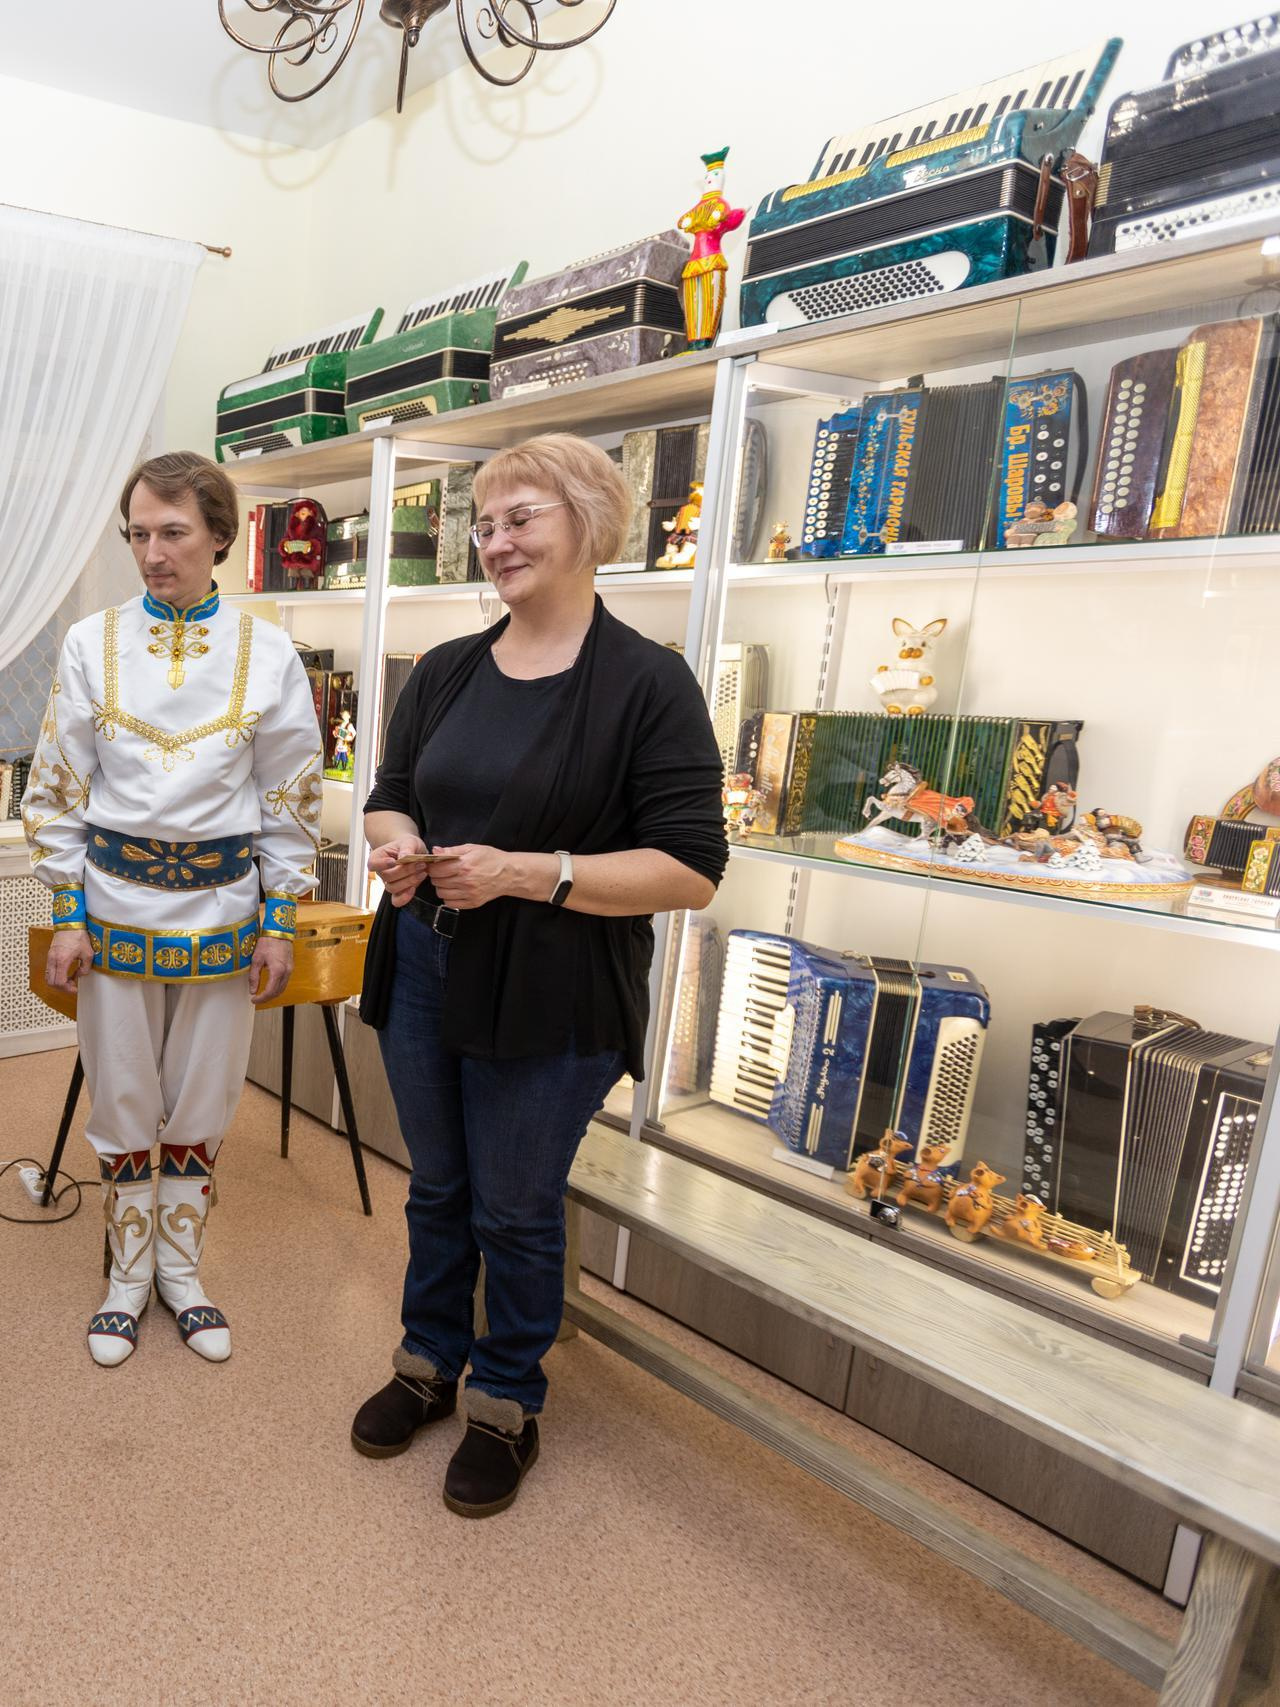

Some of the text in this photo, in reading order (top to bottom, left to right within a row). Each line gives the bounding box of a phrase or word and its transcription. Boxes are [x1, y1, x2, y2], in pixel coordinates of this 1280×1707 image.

[885, 408, 918, 545] ТУЛЬСКАЯ ГАРМОНЬ
[1004, 424, 1031, 518] Бр. Шаровы
